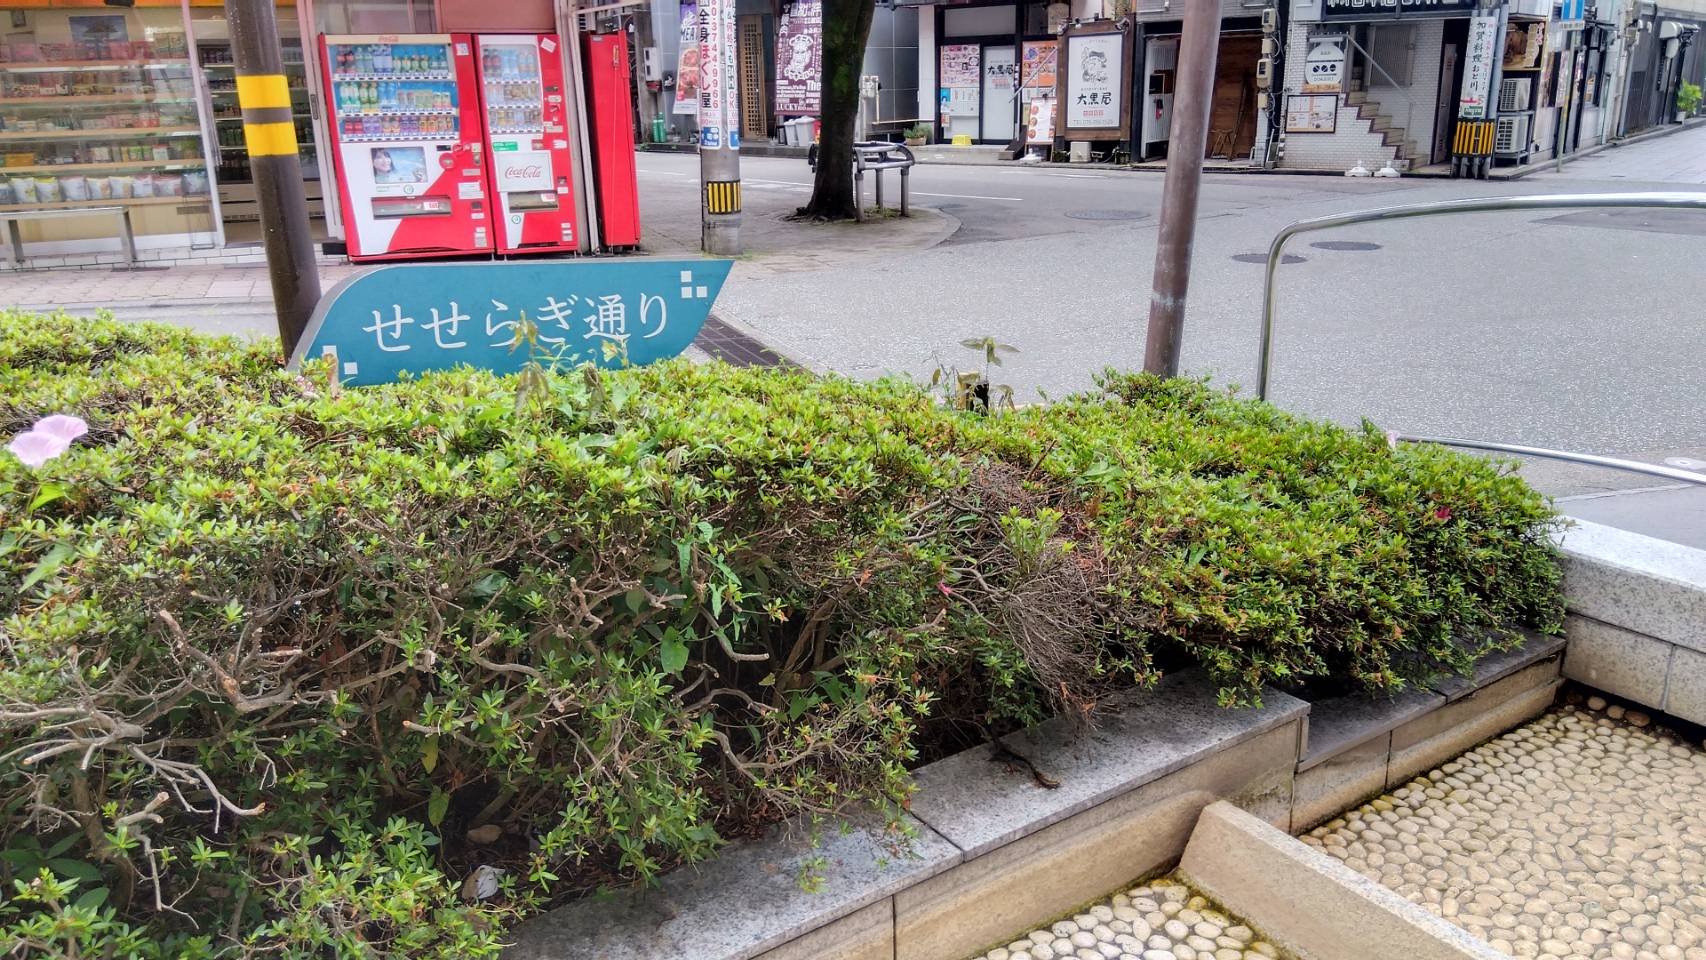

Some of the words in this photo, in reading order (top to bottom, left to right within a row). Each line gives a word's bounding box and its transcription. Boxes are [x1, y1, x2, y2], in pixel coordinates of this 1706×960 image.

[988, 63, 1013, 75] 大黒屋
[1076, 92, 1112, 105] 大黒屋
[362, 292, 668, 353] せせらぎ通り
